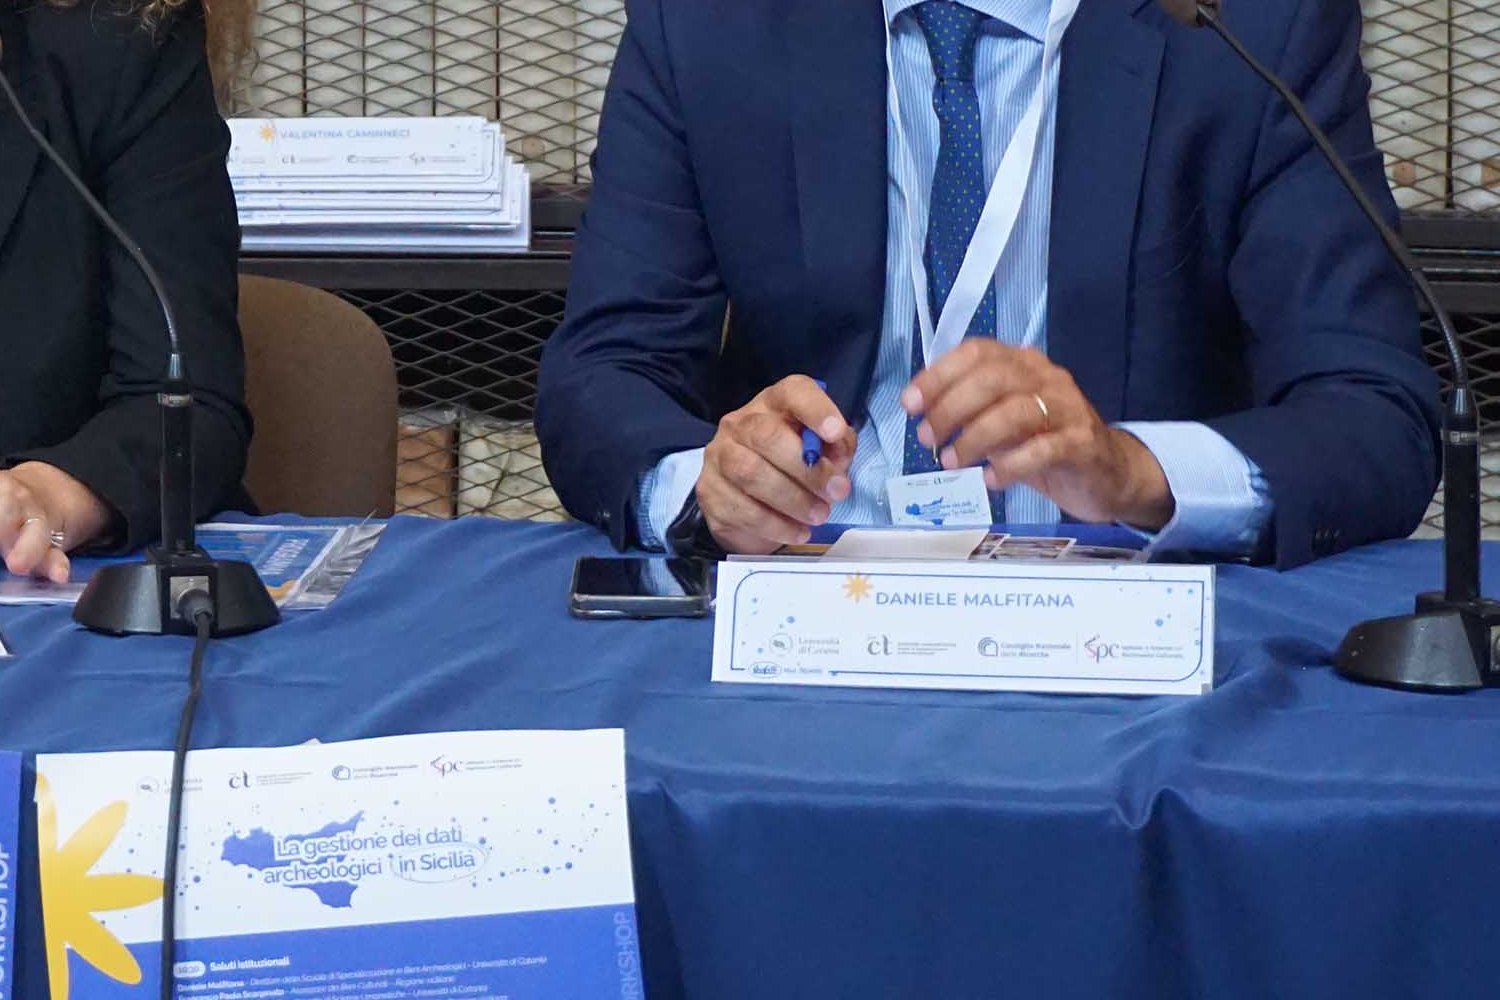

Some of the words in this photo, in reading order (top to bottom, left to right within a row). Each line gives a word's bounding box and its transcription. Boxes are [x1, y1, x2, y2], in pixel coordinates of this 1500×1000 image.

[876, 592, 957, 606] DANIELE
[963, 593, 1074, 608] MALFITANA
[276, 837, 299, 856] La
[303, 832, 388, 859] gestione
[391, 829, 421, 847] dei
[425, 826, 462, 844] dati
[263, 860, 382, 884] archeologici
[398, 855, 416, 873] in
[419, 852, 476, 871] Sicilia
[210, 960, 237, 971] Saluti
